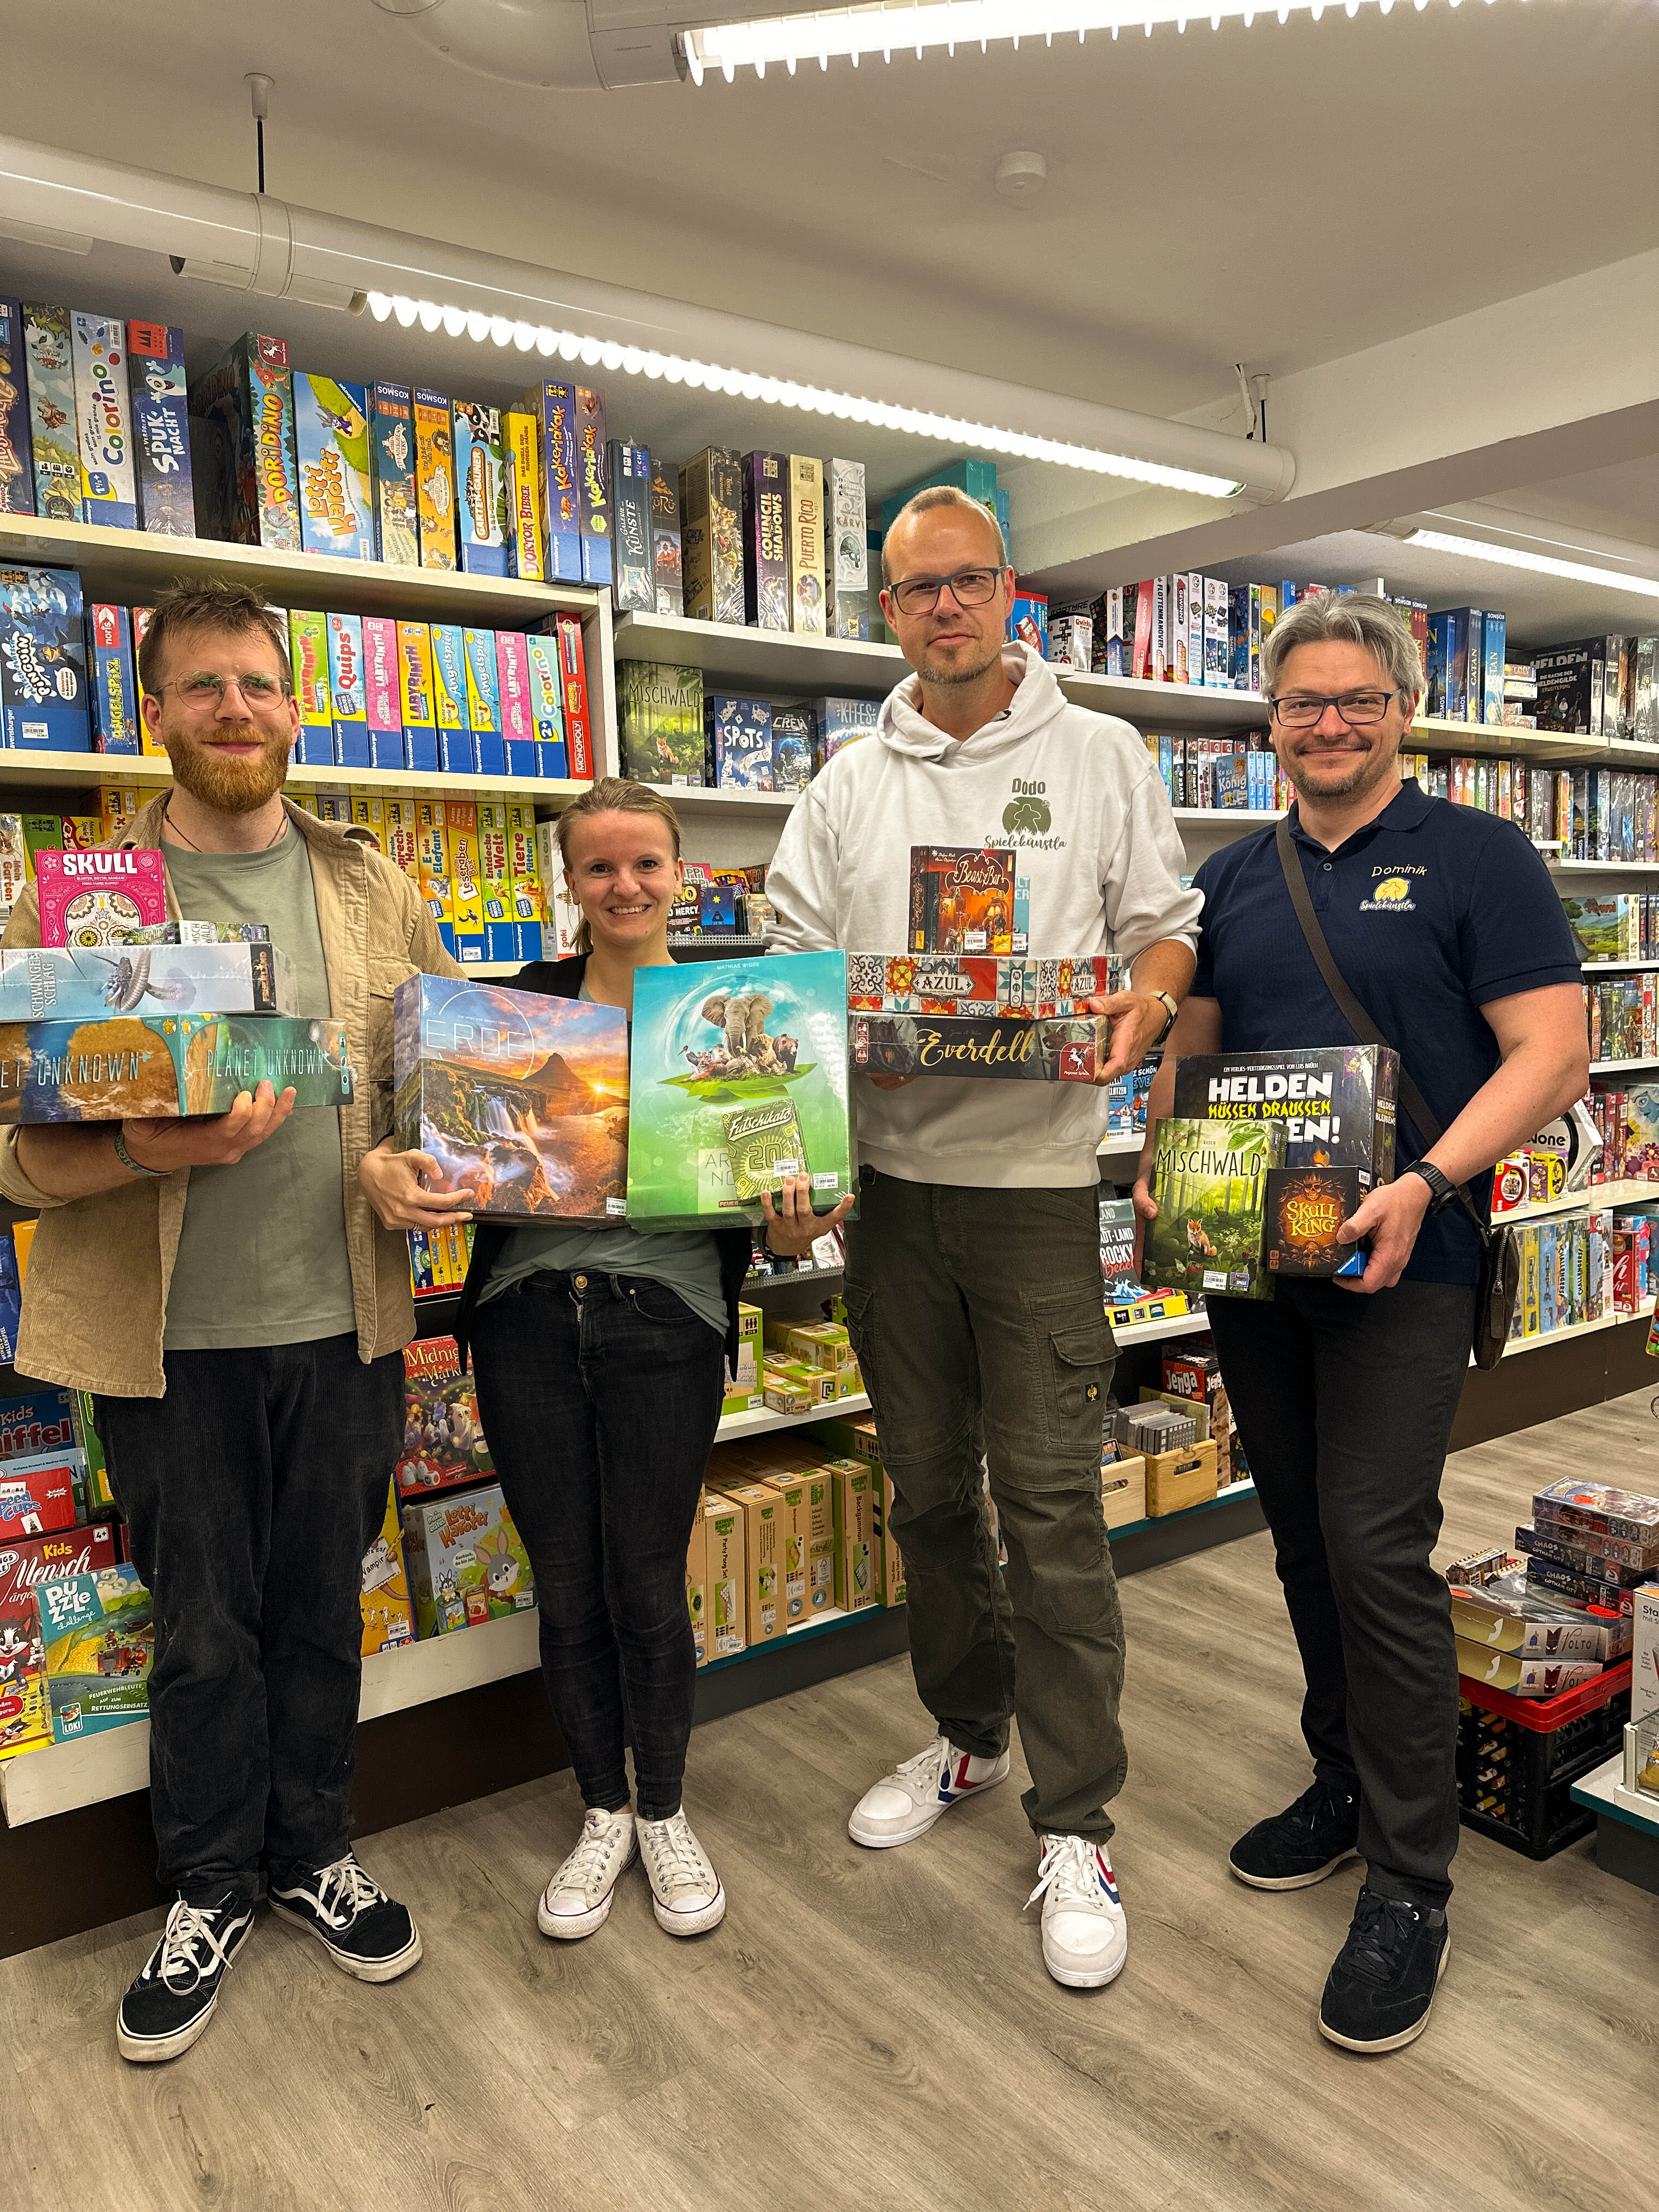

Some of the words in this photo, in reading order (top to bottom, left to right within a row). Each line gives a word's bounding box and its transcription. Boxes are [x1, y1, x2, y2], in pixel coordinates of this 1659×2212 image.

[338, 383, 363, 413] Ravensburger
[377, 385, 409, 399] KOSMOS
[416, 392, 448, 405] KOSMOS
[92, 363, 124, 466] Colorino
[167, 407, 185, 455] NACHT
[303, 464, 329, 518] Lotti
[319, 447, 357, 536] Karotti
[475, 450, 487, 540] GARTEN-GAUNER
[518, 485, 532, 521] BIBBER
[619, 506, 628, 535] GALERIE
[798, 499, 817, 525] RICO
[837, 516, 865, 530] KARVI
[625, 499, 644, 556] KÜNSTE
[760, 492, 774, 561] COUNCIL
[772, 493, 783, 562] SHADOWS
[521, 522, 540, 574] DOKTOR
[799, 526, 817, 570] PUERTO
[102, 621, 113, 645] noris
[338, 632, 356, 690] Quips
[373, 633, 386, 687] LABYRINTH
[442, 629, 462, 698] Angelspiel
[473, 632, 495, 701] Angelspiel
[505, 646, 518, 698] LABYRINTH
[1531, 651, 1588, 669] HELDEN
[299, 636, 318, 713] LABYRINTH
[405, 645, 423, 720] LABYRINTH
[531, 647, 557, 718] Colorino
[106, 657, 125, 740] ANGELSPIEL
[629, 682, 701, 708] MISCHWALD
[772, 716, 809, 731] CREW
[838, 702, 874, 724] KITES
[7, 708, 15, 749] avensburger
[540, 721, 552, 738] 2+
[723, 724, 764, 748] SPOTS
[442, 731, 450, 771] Ravensburger
[475, 733, 483, 773] Ravensburger
[573, 721, 585, 772] MONOPOLY
[1012, 777, 1046, 795] Dodo
[1218, 774, 1248, 793] König
[404, 831, 415, 862] Hexe
[432, 829, 443, 874] Elefant
[493, 833, 506, 870] Welt
[512, 832, 527, 878] Tiere
[526, 837, 537, 874] füttern
[984, 834, 1068, 851] Spielekünstla
[62, 853, 138, 876] SKULL
[454, 837, 474, 896] Leseraben
[467, 859, 478, 877] Box
[483, 833, 494, 879] Entdecke
[3, 861, 13, 901] Garten
[13, 860, 21, 881] Mein
[952, 860, 988, 887] Beasty
[985, 865, 1002, 886] Bar
[1372, 863, 1427, 878] Dominik
[675, 905, 698, 916] MERCY
[1360, 900, 1414, 911] Spielekünstla
[191, 923, 201, 944] MISCH
[201, 924, 210, 944] WALD
[561, 929, 569, 949] goki
[42, 962, 56, 1007] SCHLAG
[260, 951, 268, 1003] FEUERLAND
[921, 974, 964, 991] AZUL
[1073, 977, 1093, 992] AZUL
[426, 1018, 527, 1060] ERDE
[914, 1028, 1036, 1067] Everdell
[37, 1052, 141, 1086] UNKNOWN
[206, 1049, 258, 1078] PLANET
[267, 1050, 326, 1076] UNKNOWN
[1138, 1065, 1158, 1076] SCHÖN
[1208, 1071, 1333, 1103] HELDEN
[1207, 1102, 1257, 1120] MÜSSEN
[1262, 1099, 1331, 1119] DRAUSSEN
[1377, 1099, 1395, 1111] HELDEN
[729, 1107, 793, 1139] Futschikato
[1375, 1113, 1396, 1126] BLEIBEN!
[748, 1143, 783, 1171] 20
[1156, 1149, 1262, 1178] MISCHWALD
[1285, 1200, 1339, 1221] SKULL
[1290, 1216, 1335, 1238] KING
[1099, 1243, 1134, 1266] ROCKY
[1336, 1255, 1356, 1274] Ravensburger
[2, 1326, 13, 1358] ROLLENSPIEL
[1166, 1369, 1198, 1395] Jenga
[0, 1406, 35, 1426] Kids
[851, 1475, 868, 1483] NATURAL
[785, 1488, 803, 1497] NATURAL
[3, 1501, 41, 1521] Cups
[427, 1511, 442, 1525] Mein
[444, 1503, 476, 1527] Lotti
[715, 1516, 735, 1526] NATURAL
[95, 1530, 107, 1539] 4+
[439, 1511, 489, 1549] Karotti
[715, 1522, 729, 1531] GAMES
[43, 1542, 73, 1560] Kids
[1532, 1547, 1553, 1559] GOTHAM
[1553, 1554, 1564, 1562] CITY
[1534, 1539, 1559, 1551] CHAOS
[11, 1545, 92, 1590] Mensch
[1546, 1570, 1572, 1583] CHAOS
[1544, 1578, 1565, 1590] GOTHAM
[1566, 1585, 1577, 1594] CITY
[57, 1610, 96, 1631] challenge
[1561, 1627, 1592, 1652] VOLTO
[89, 1684, 144, 1700] FEUERWEHRLEUTE,
[91, 1702, 148, 1712] RETTUNGSEINSATZ
[64, 1722, 81, 1733] LOKI
